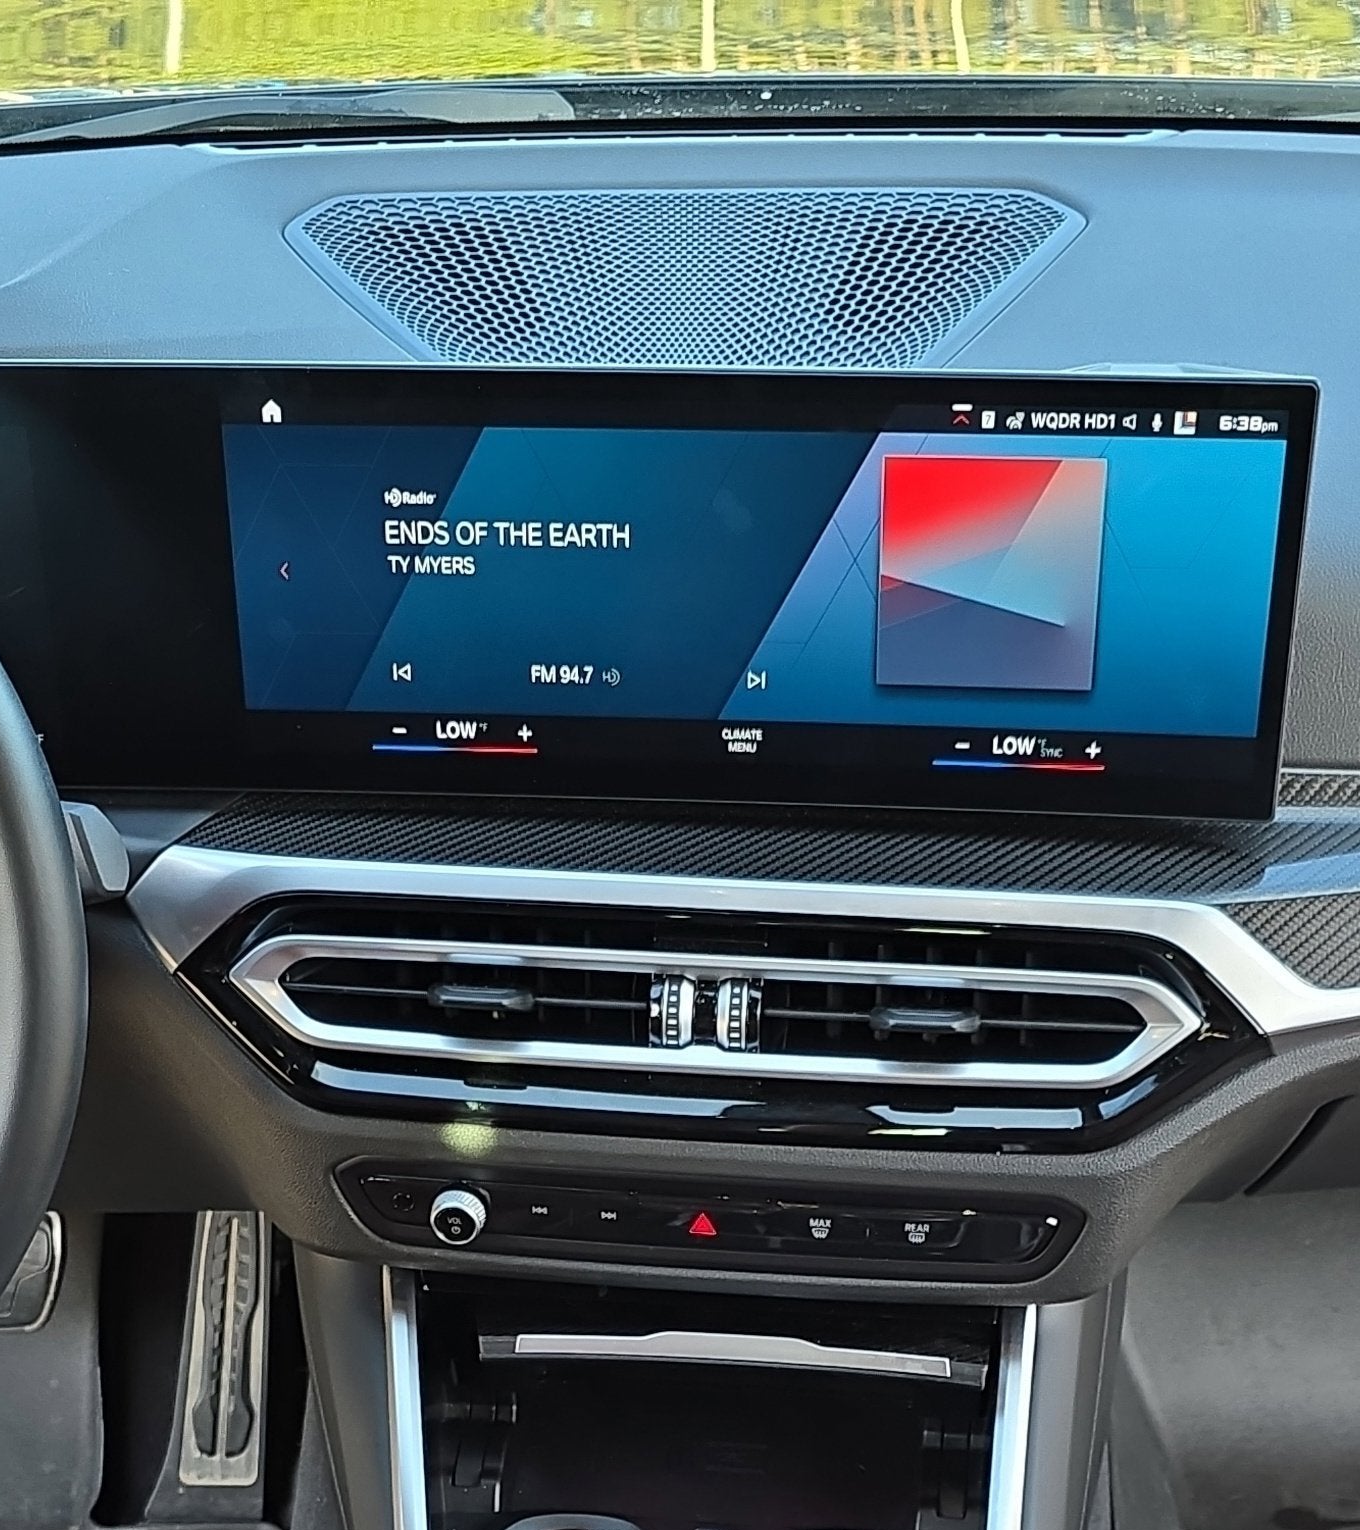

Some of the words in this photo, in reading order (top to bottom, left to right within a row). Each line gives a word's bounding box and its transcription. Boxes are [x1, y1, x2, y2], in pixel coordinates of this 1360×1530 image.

[1031, 412, 1081, 430] WQDR
[1084, 413, 1116, 430] HD1
[402, 490, 436, 505] Radio
[384, 519, 450, 546] ENDS
[455, 520, 489, 546] OF
[493, 521, 543, 547] THE
[549, 522, 630, 549] EARTH
[387, 555, 410, 574] TY
[414, 555, 476, 575] MYERS
[530, 664, 556, 684] FM
[559, 664, 594, 685] 94.7
[435, 720, 477, 740] LOW
[721, 727, 763, 741] CLIMATE
[727, 741, 758, 754] MENU
[992, 734, 1036, 756] LOW
[1040, 747, 1064, 758] SYNC
[446, 1216, 463, 1225] VOL
[809, 1217, 832, 1228] MAX
[904, 1222, 930, 1233] REAR
